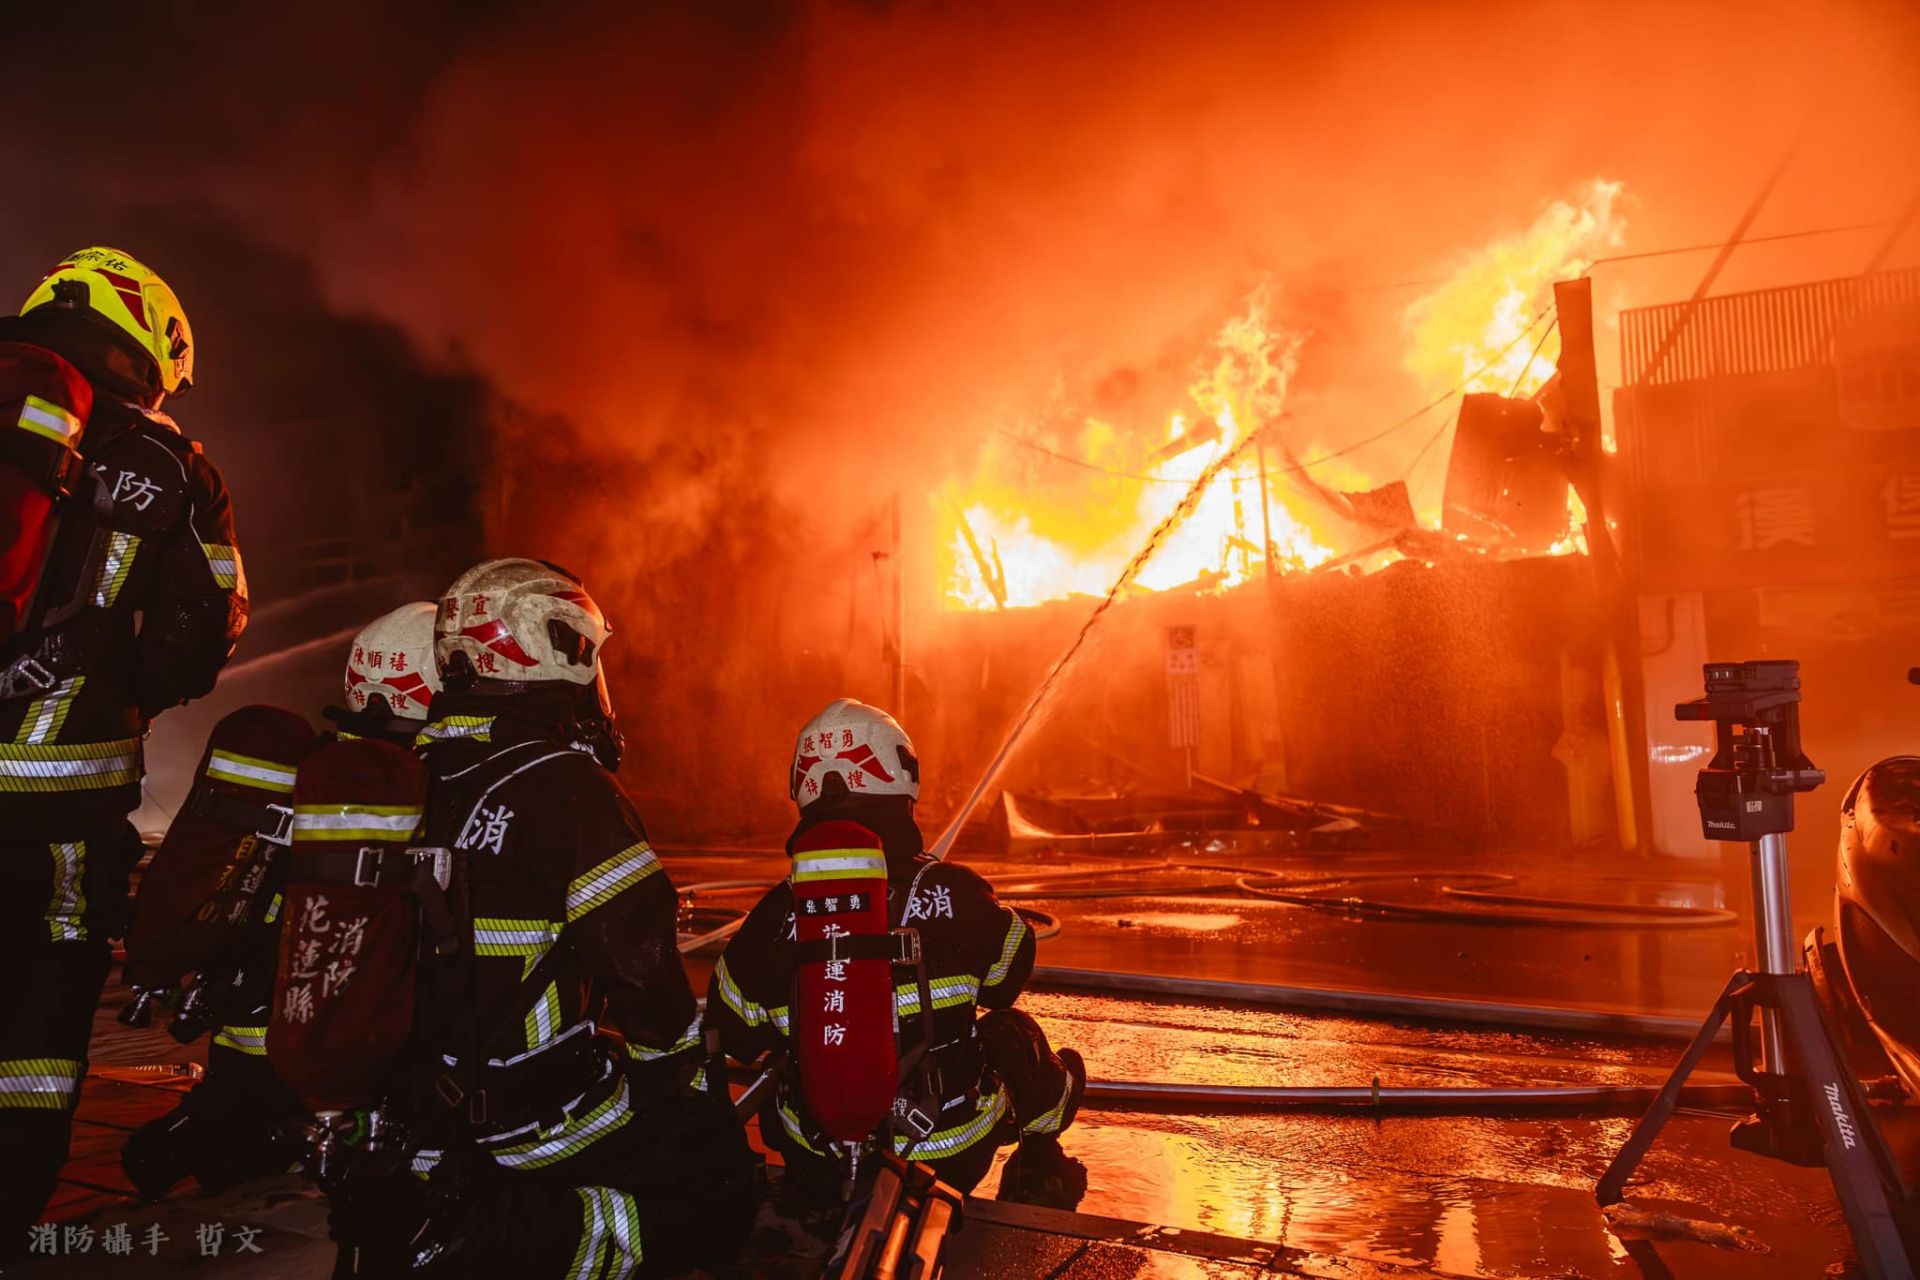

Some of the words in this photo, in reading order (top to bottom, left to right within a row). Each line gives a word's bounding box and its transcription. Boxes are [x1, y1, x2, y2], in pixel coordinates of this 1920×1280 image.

[96, 464, 164, 512] 防
[353, 646, 409, 672] 陳順禧
[803, 728, 854, 754] 張智勇
[805, 769, 867, 796] 特搜
[462, 804, 515, 856] 消
[805, 893, 862, 914] 張智勇
[282, 893, 331, 1025] 花蓮縣
[322, 916, 369, 999] 消防
